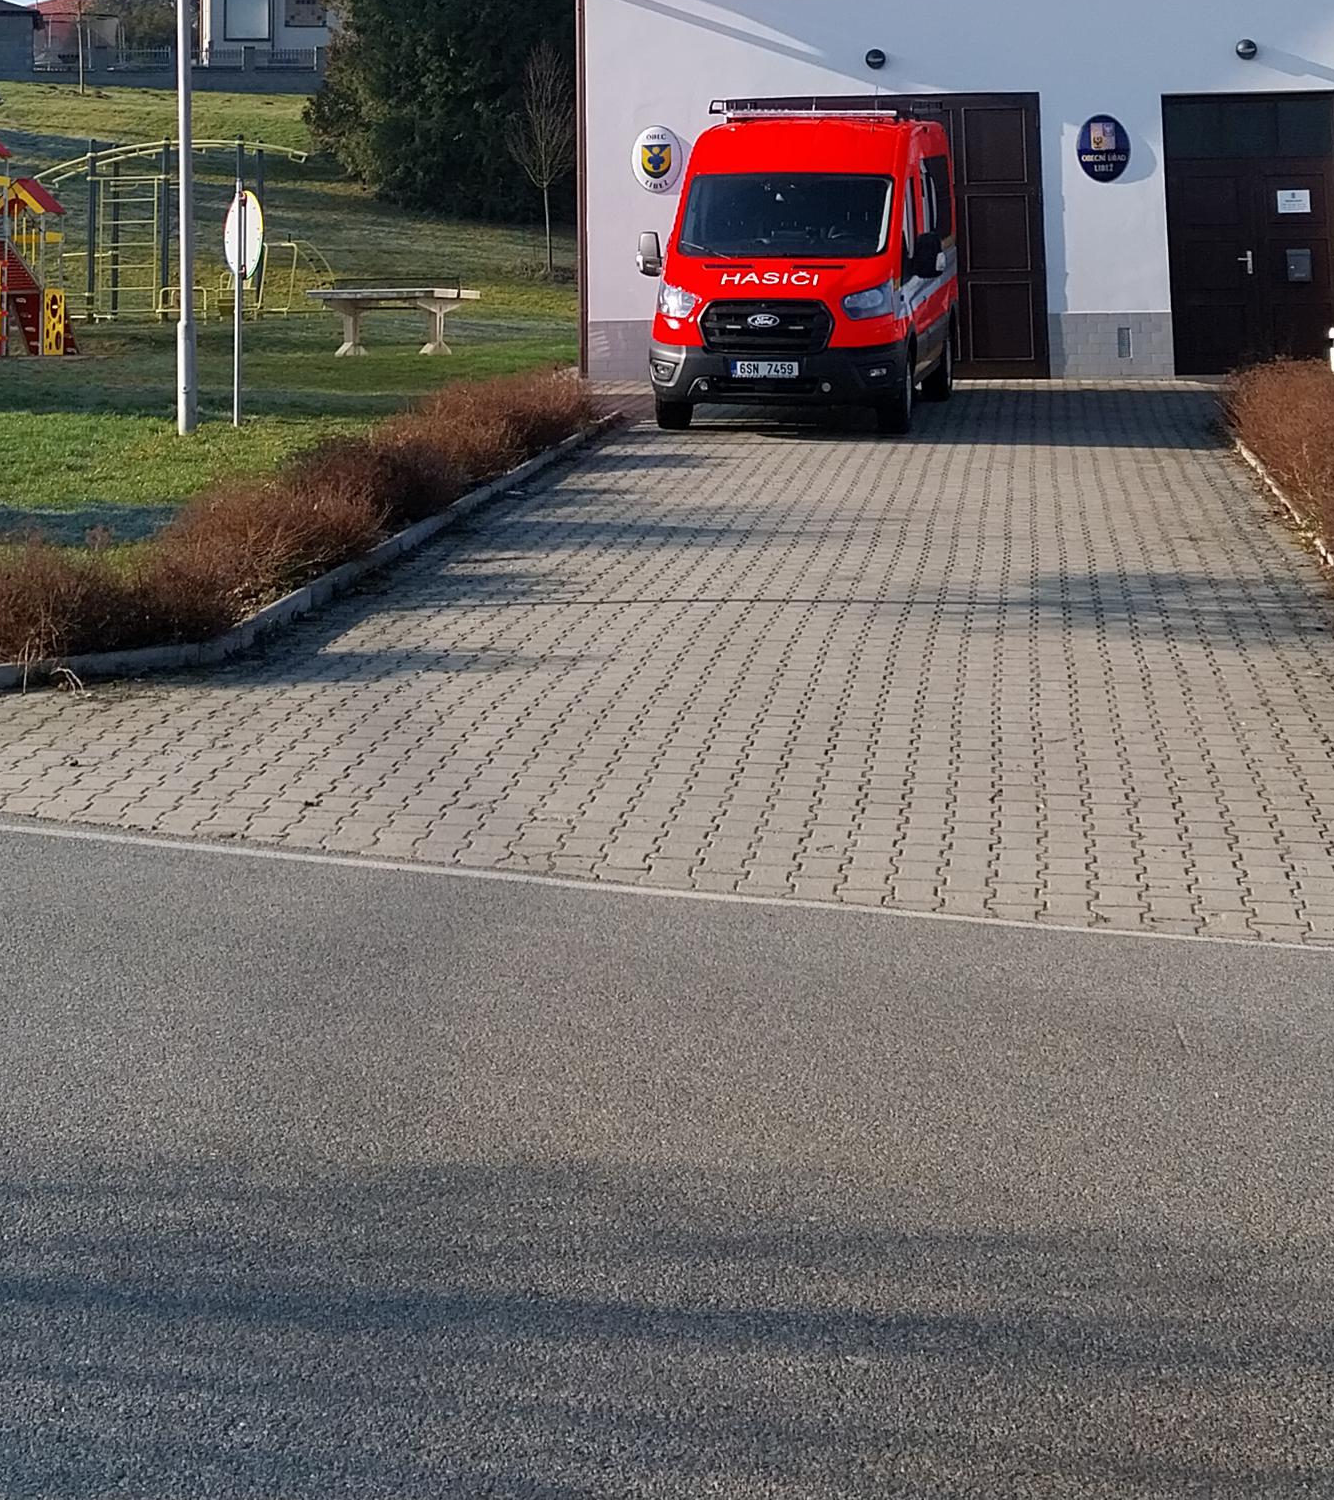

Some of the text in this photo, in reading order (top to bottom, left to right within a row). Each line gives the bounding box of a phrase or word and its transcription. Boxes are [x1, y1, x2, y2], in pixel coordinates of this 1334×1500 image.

[720, 271, 819, 286] HASIČI
[739, 363, 794, 375] 6SN 7459
